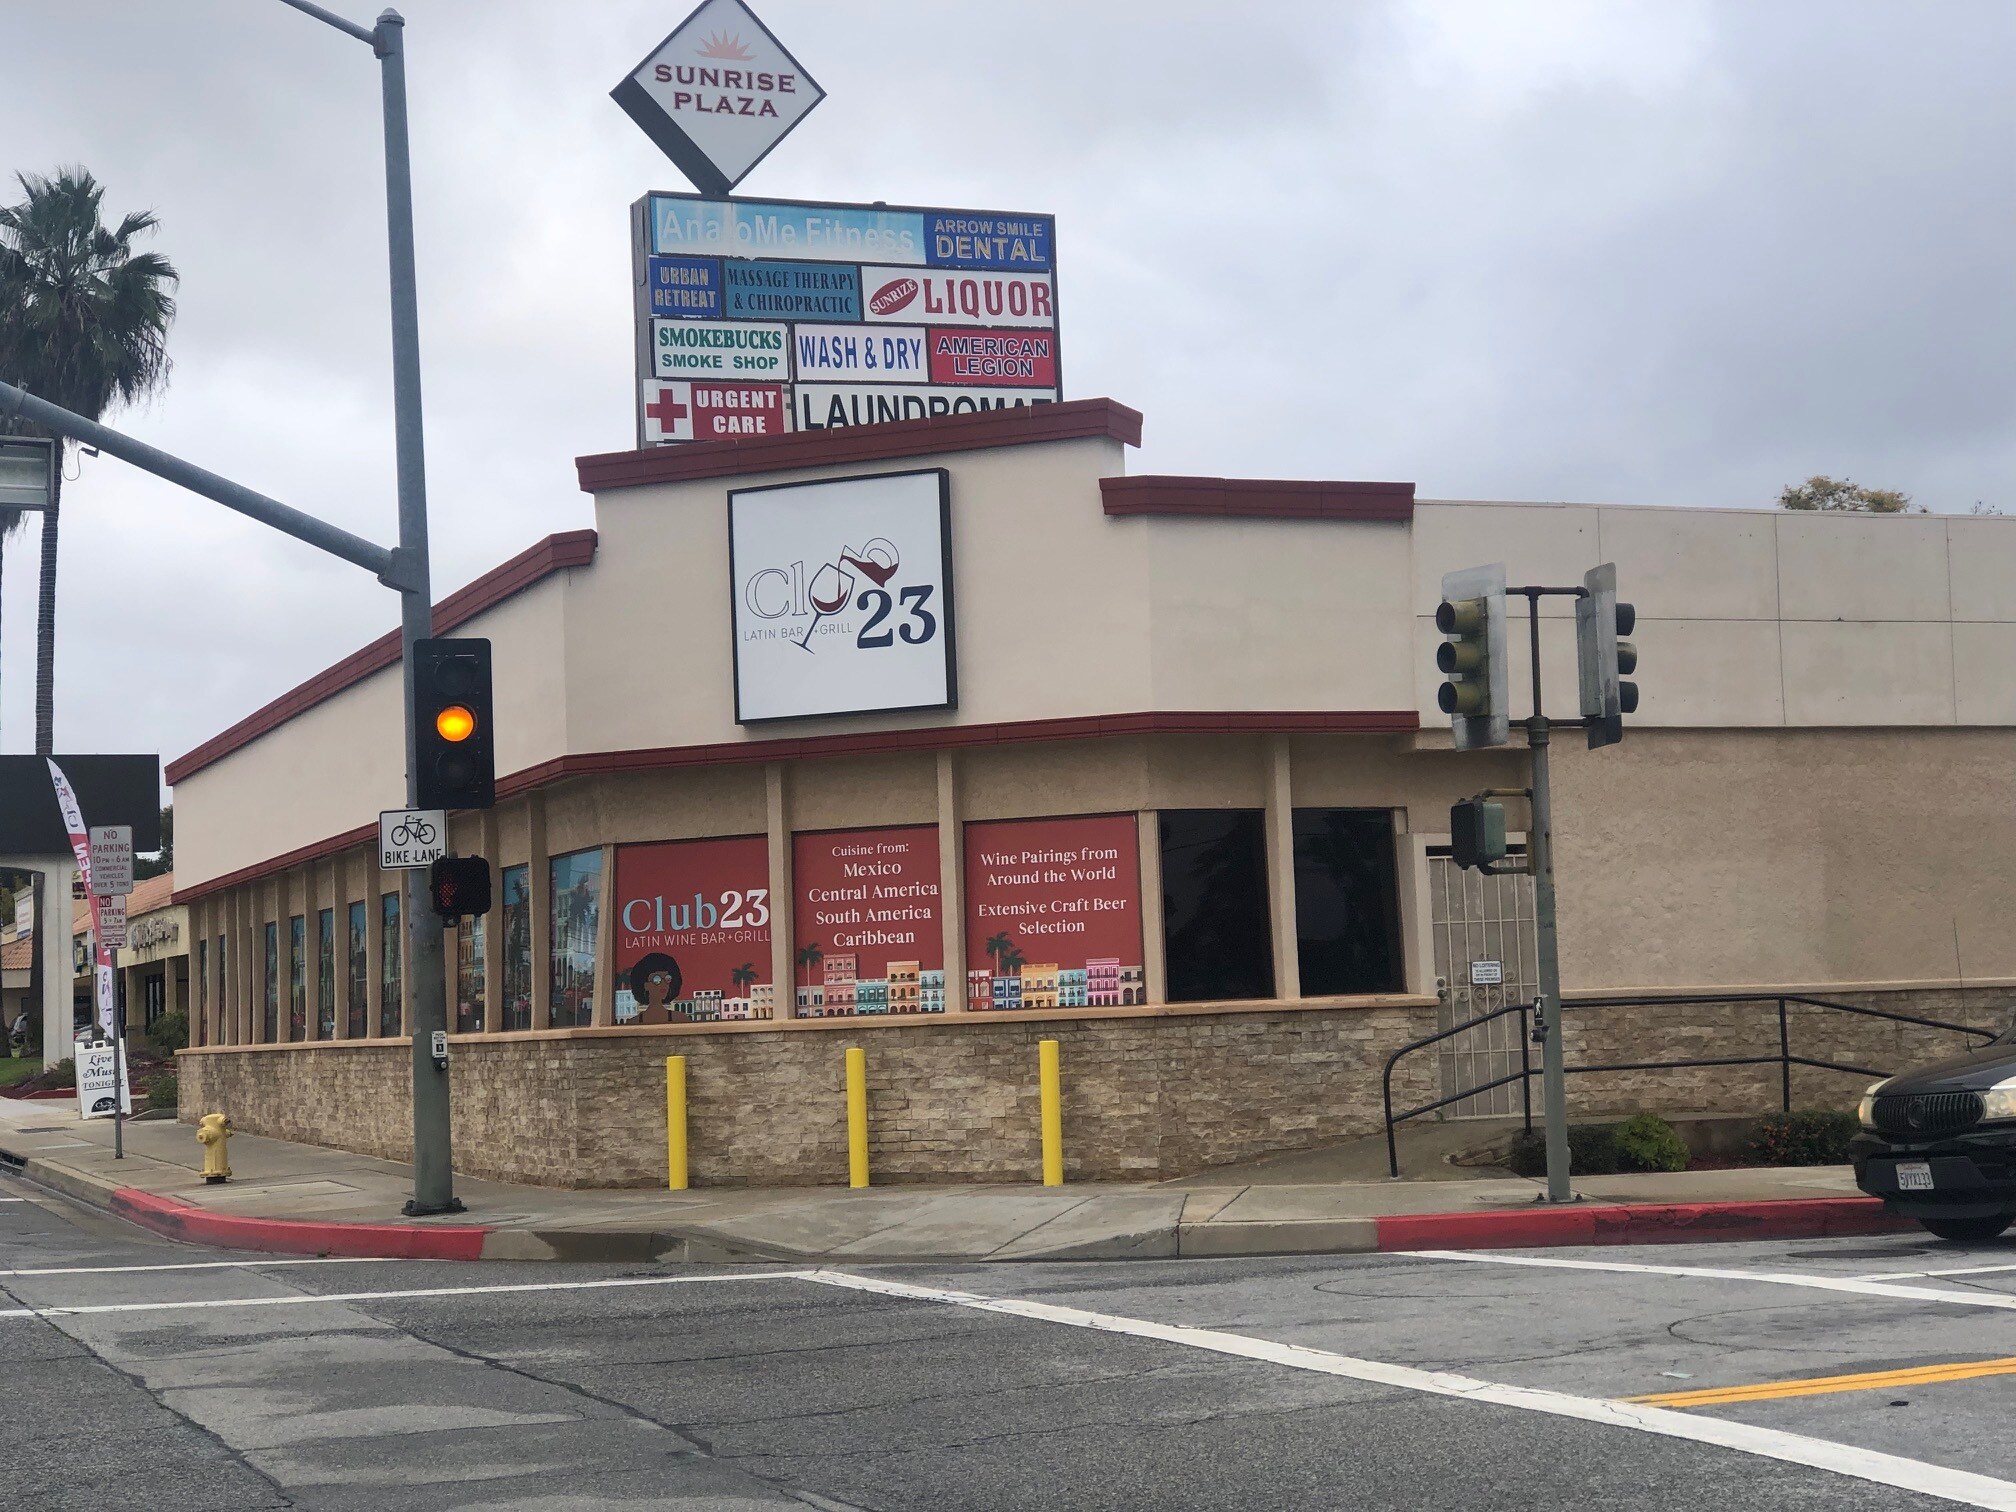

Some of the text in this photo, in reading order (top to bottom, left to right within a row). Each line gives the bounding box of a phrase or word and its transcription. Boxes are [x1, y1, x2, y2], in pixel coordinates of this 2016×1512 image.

[655, 64, 796, 94] SUNRISE
[674, 92, 779, 117] PLAZA
[662, 210, 914, 251] AnaoMe Fitness
[934, 219, 1043, 237] ARROW SMILE
[936, 235, 1046, 262] DENTAL
[660, 266, 709, 286] URBAN
[727, 268, 855, 291] MASSAGE THERAPY
[654, 289, 716, 308] RETREAT
[734, 293, 853, 314] & CHIROPRACTIC
[870, 279, 918, 315] SUNRIZE
[922, 278, 1052, 319] LIQUOR
[659, 327, 782, 350] SMOKEBUCKS
[937, 336, 1050, 358] AMERICAN
[662, 354, 779, 370] SMOKE SHOP
[799, 335, 921, 370] WASH & DRY
[954, 357, 1034, 377] LEGION
[696, 390, 777, 409] URGENT
[713, 415, 767, 434] CARE
[744, 629, 777, 641] LATIN
[781, 627, 804, 639] BAR
[103, 830, 118, 840] NO
[92, 843, 130, 854] PARKING
[385, 850, 410, 864] BIKE
[832, 843, 910, 857] Cuisine from:
[980, 847, 1118, 866] Wine Pairings from
[93, 856, 101, 864] 10
[116, 855, 121, 863] 6
[844, 860, 902, 878] Mexico
[987, 866, 1116, 886] Around the World
[809, 881, 939, 902] Central America
[100, 897, 111, 907] NO
[978, 897, 1127, 917] Extensive Craft Beer
[100, 908, 125, 917] PARKING
[816, 905, 932, 925] South America
[1018, 919, 1085, 935] Selection
[625, 936, 660, 949] LATIN
[664, 933, 696, 946] WINE
[833, 930, 915, 947] Caribbean
[88, 1055, 113, 1067] Live
